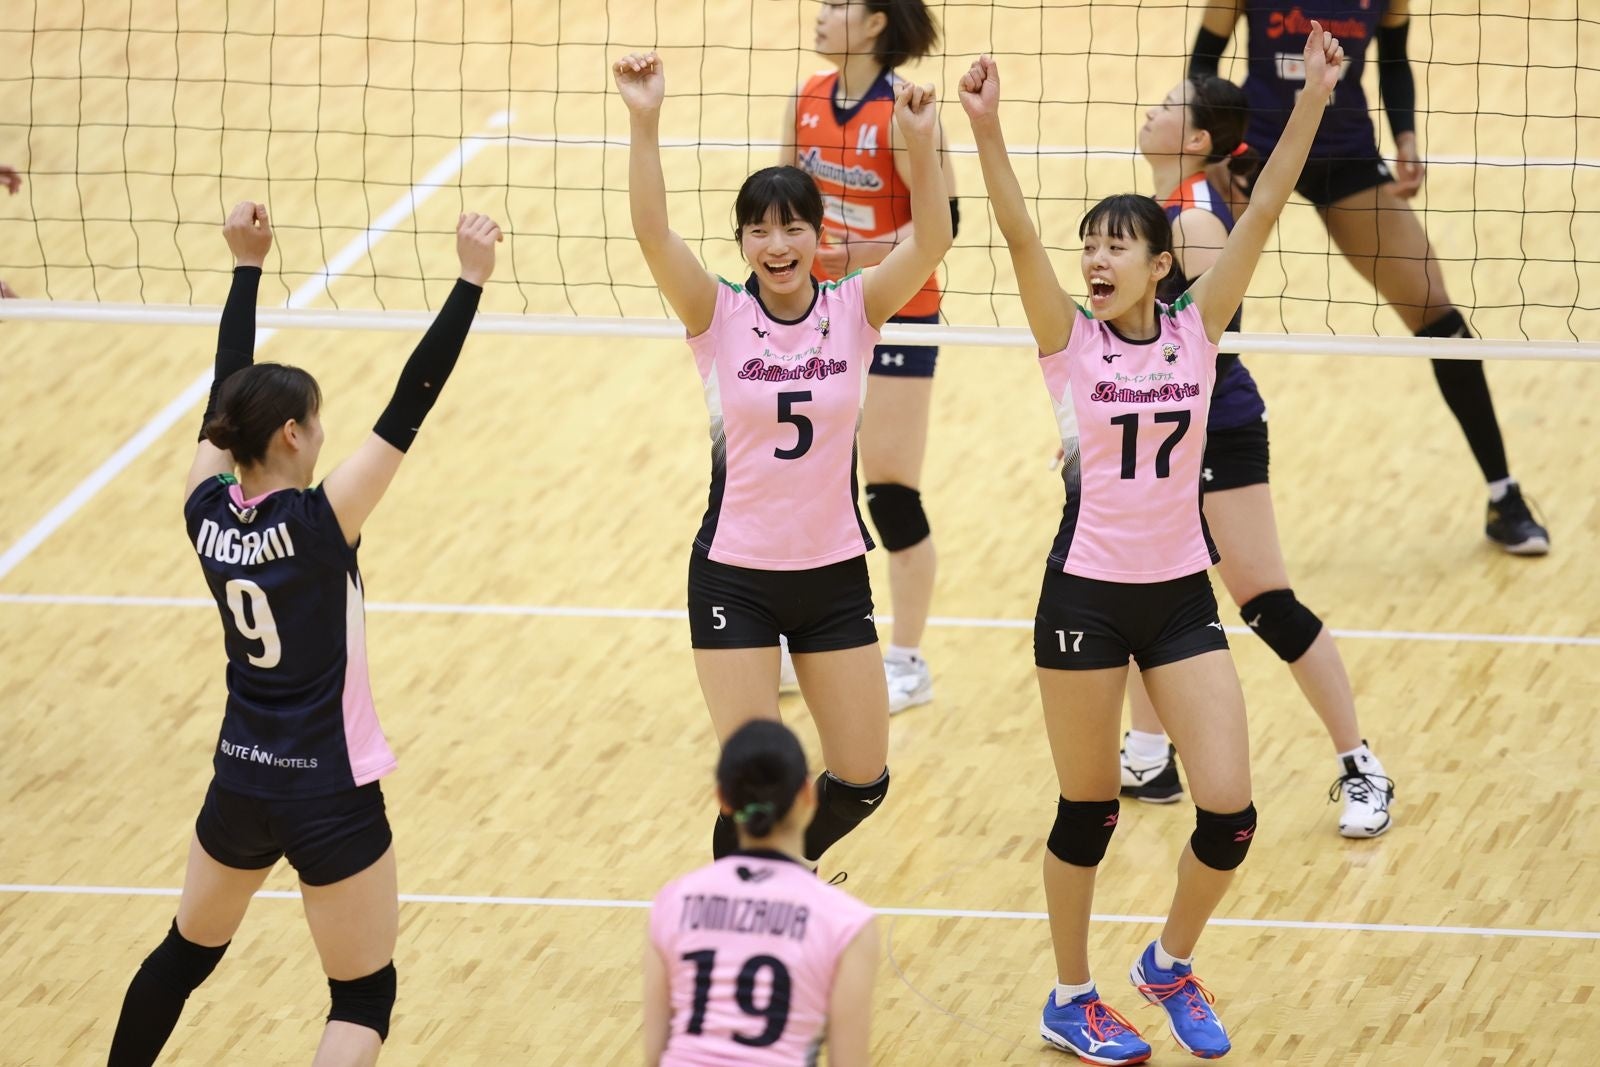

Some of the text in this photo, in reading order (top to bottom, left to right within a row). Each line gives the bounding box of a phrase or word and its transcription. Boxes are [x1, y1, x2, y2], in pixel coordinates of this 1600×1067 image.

[855, 123, 878, 157] 14
[738, 357, 847, 382] Brilliant Aries
[1091, 381, 1159, 403] Brilliant
[774, 390, 814, 460] 5
[1110, 410, 1192, 480] 17
[225, 578, 282, 669] 9
[712, 606, 727, 630] 5
[1055, 630, 1084, 652] 17
[273, 758, 318, 768] HOTELS
[681, 947, 793, 1048] 19
